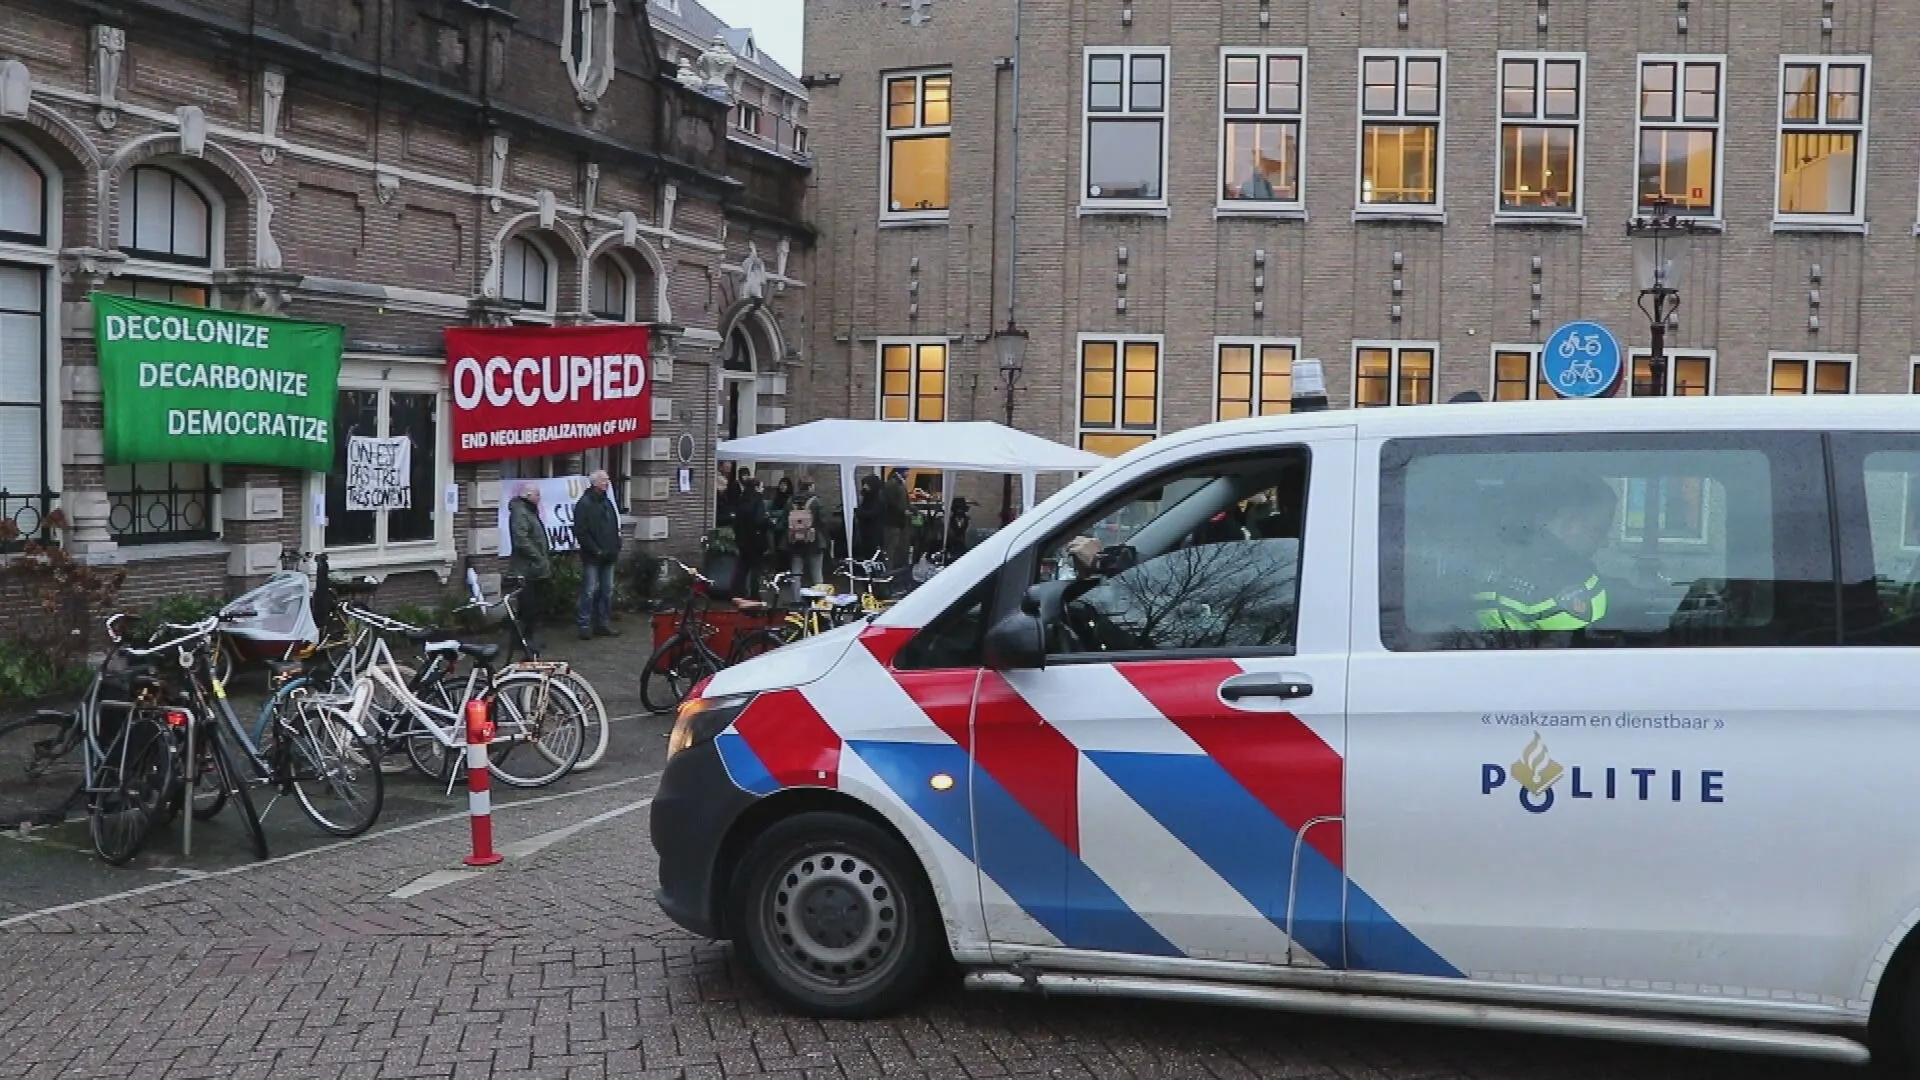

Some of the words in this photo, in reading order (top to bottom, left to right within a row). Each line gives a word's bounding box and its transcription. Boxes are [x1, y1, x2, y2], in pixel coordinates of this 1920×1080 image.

[106, 315, 269, 349] DECOLONIZE
[139, 362, 308, 397] DECARBONIZE
[453, 354, 645, 410] OCCUPIED
[168, 409, 328, 443] DEMOCRATIZE
[462, 432, 488, 449] END
[490, 422, 601, 447] NEOLIBERALIZATION
[603, 420, 617, 435] OF
[1495, 711, 1587, 728] waakzaam
[1590, 716, 1612, 728] en
[1615, 712, 1710, 730] dienstbaar
[1481, 763, 1724, 814] POLITIE
